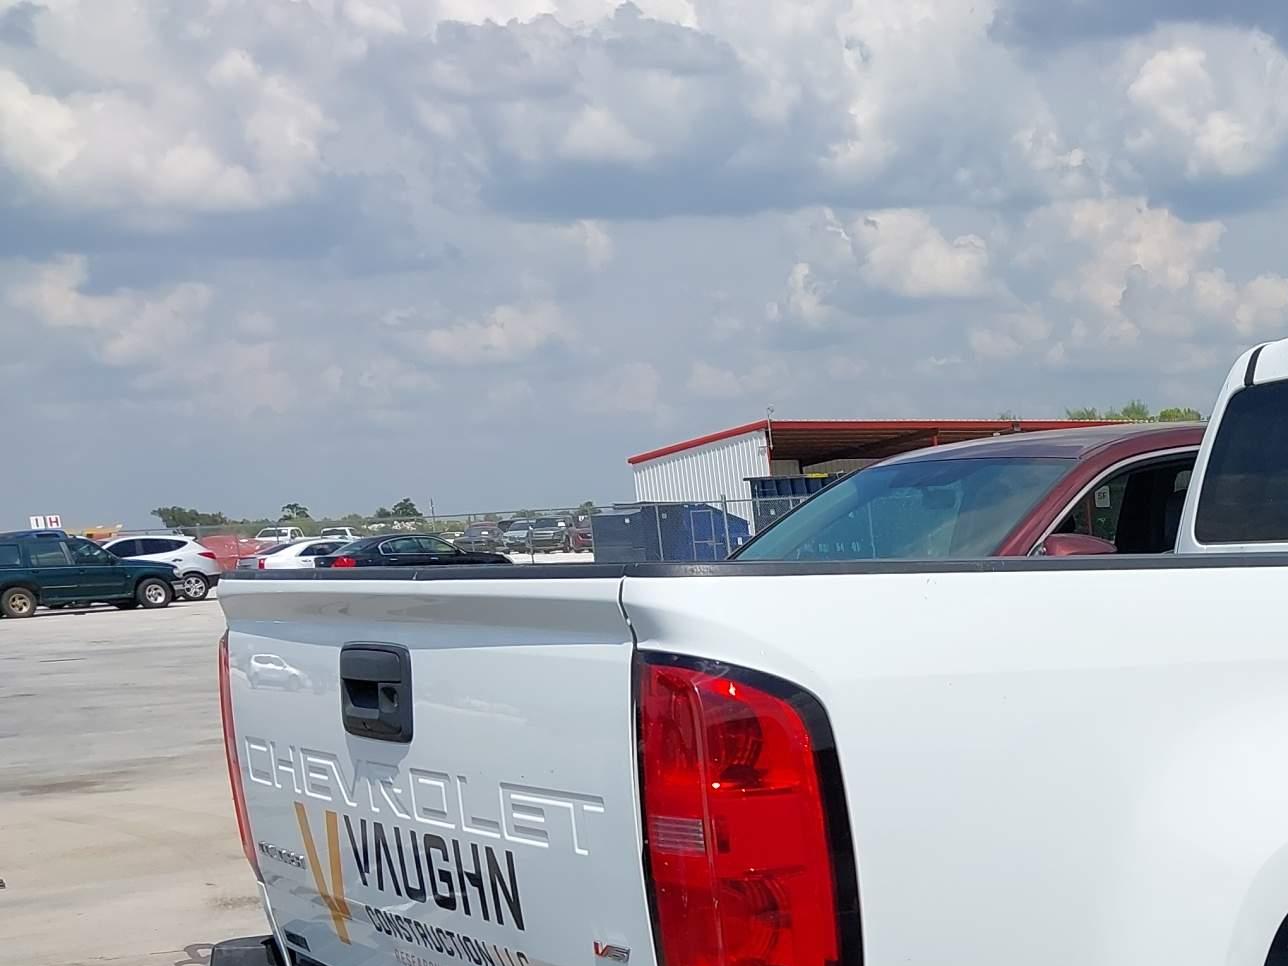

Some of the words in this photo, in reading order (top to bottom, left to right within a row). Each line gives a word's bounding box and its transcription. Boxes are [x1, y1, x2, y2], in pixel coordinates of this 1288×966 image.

[244, 735, 605, 856] CHEVROLET
[344, 815, 525, 931] VAUGHN
[593, 941, 631, 963] V6
